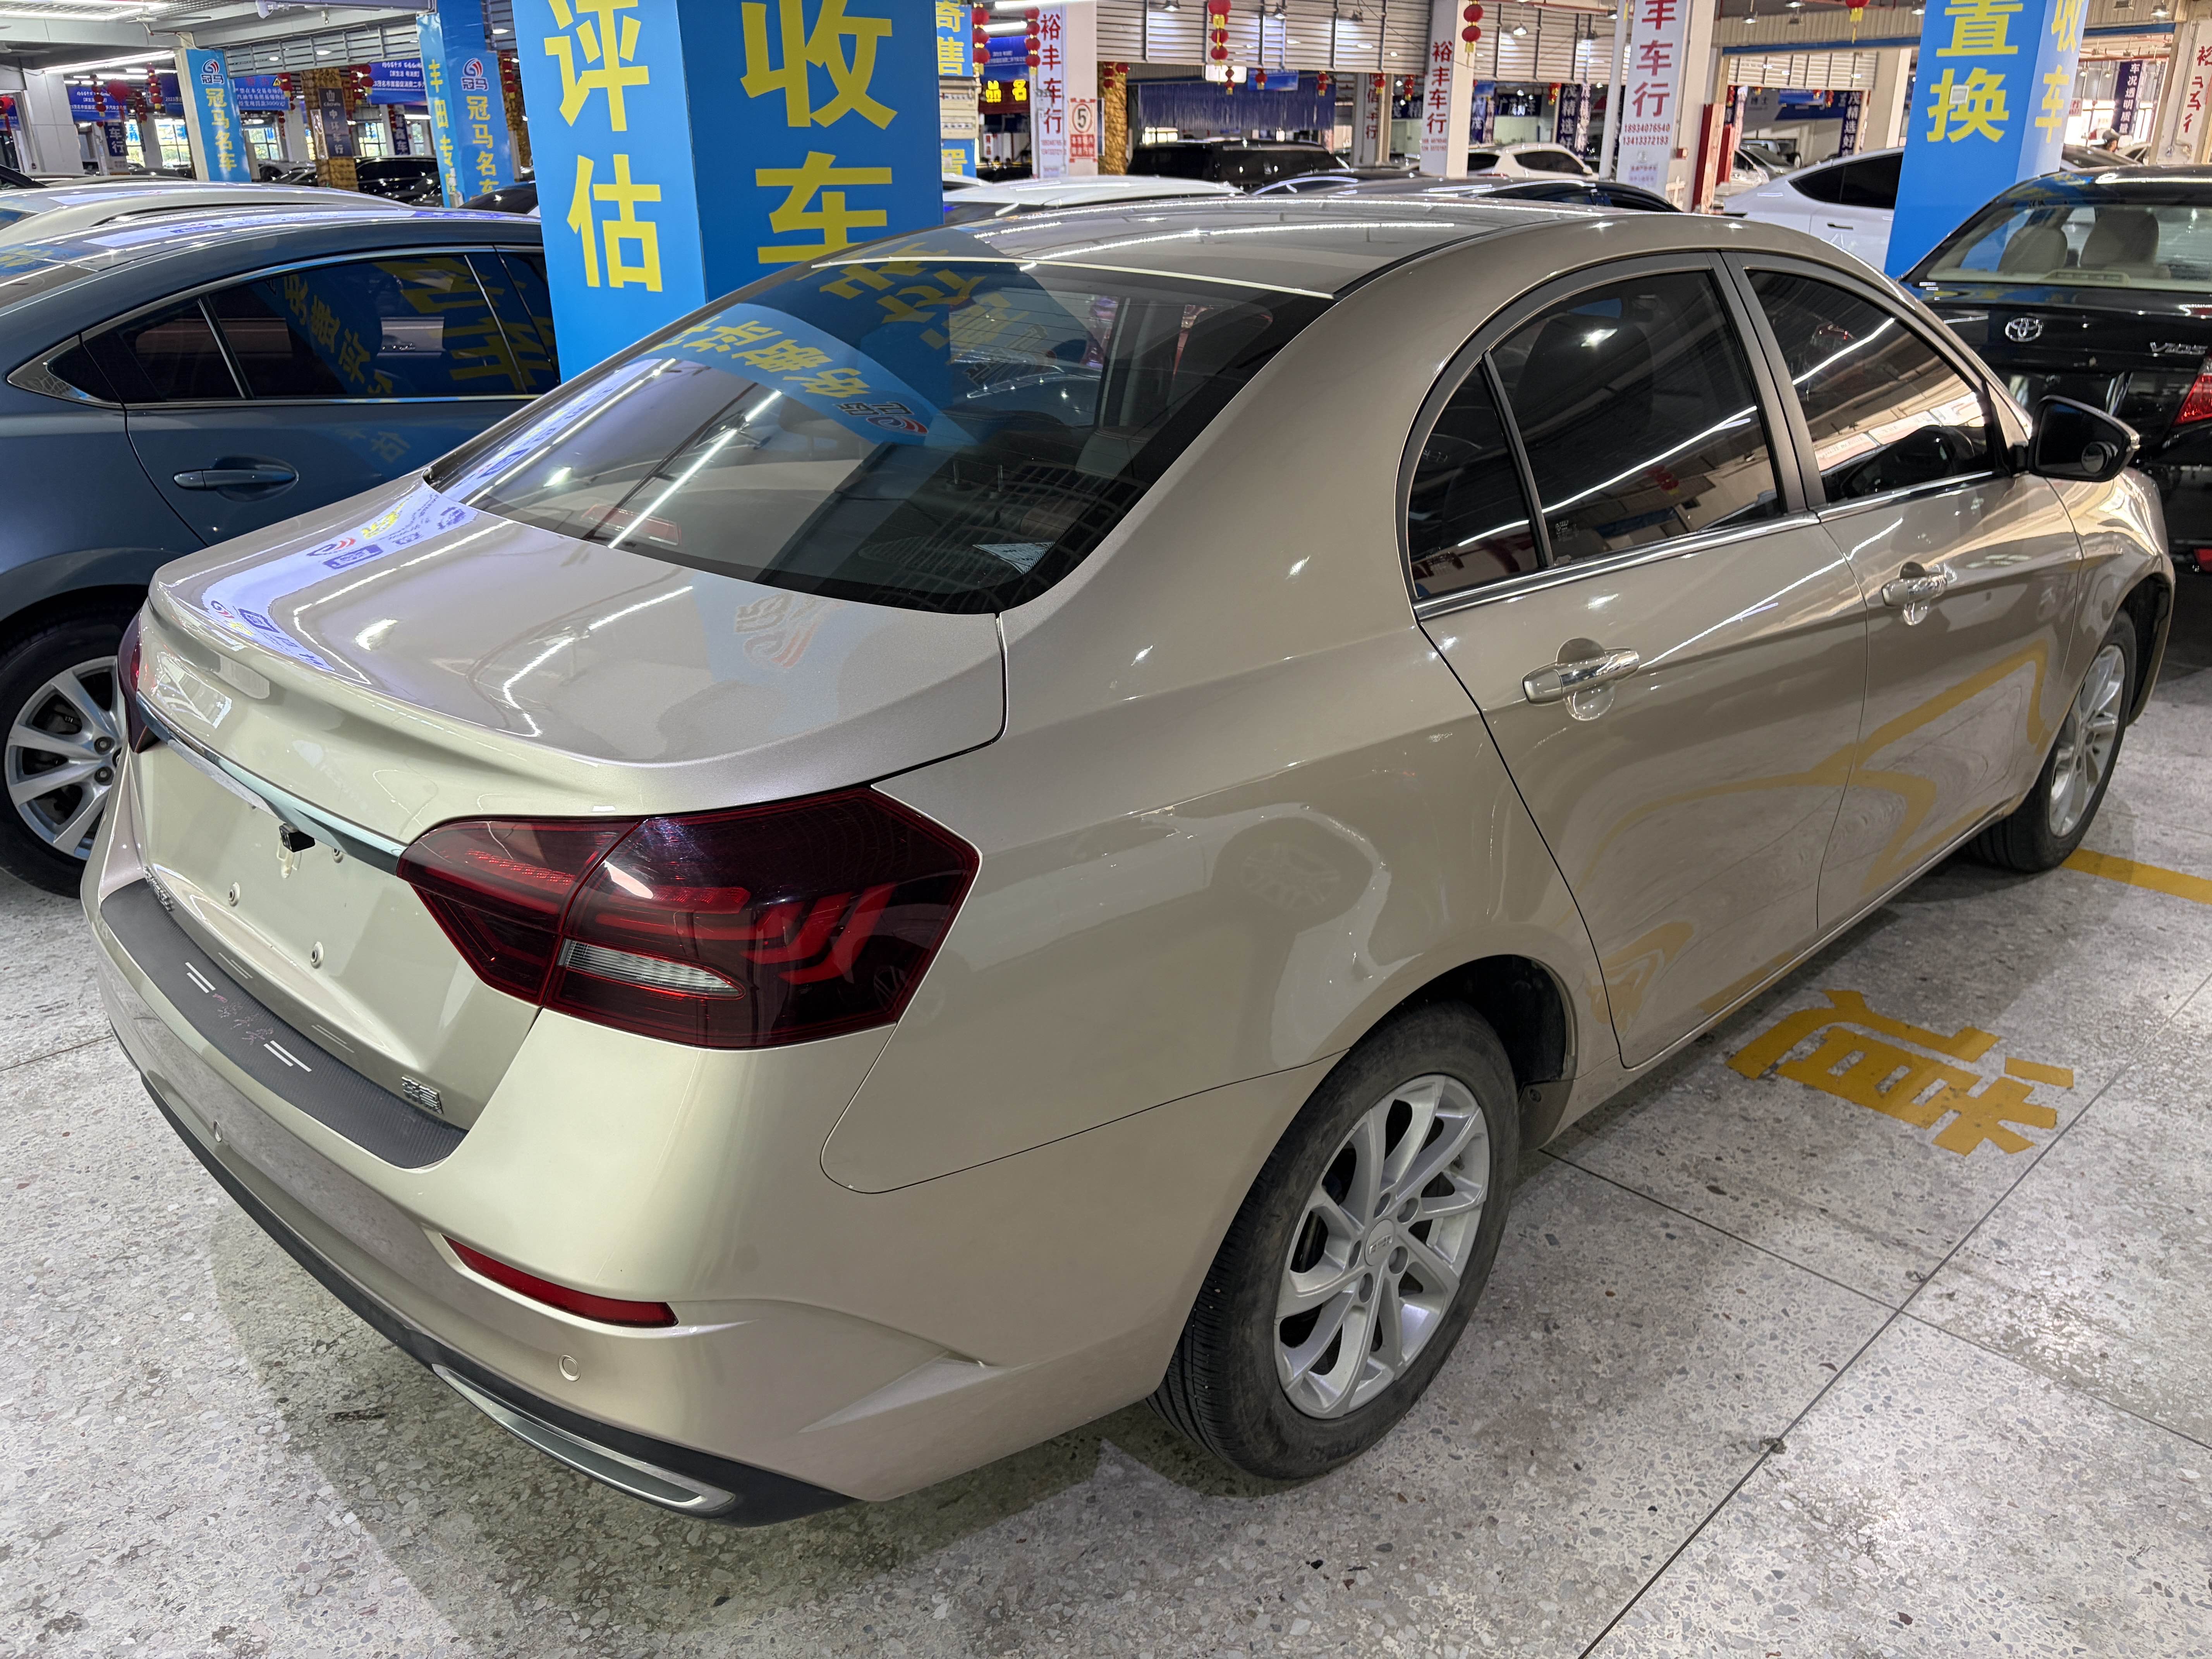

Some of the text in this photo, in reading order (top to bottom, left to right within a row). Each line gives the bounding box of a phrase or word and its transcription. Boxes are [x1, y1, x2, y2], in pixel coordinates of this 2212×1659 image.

[200, 74, 225, 84] 冠马
[461, 78, 488, 91] 冠马
[1041, 14, 1062, 134] 裕丰车行
[1077, 108, 1086, 128] 5
[1427, 40, 1453, 134] 裕丰车行
[205, 88, 237, 171] 冠马名车
[544, 0, 663, 292] 评估
[740, 0, 898, 264] 收车
